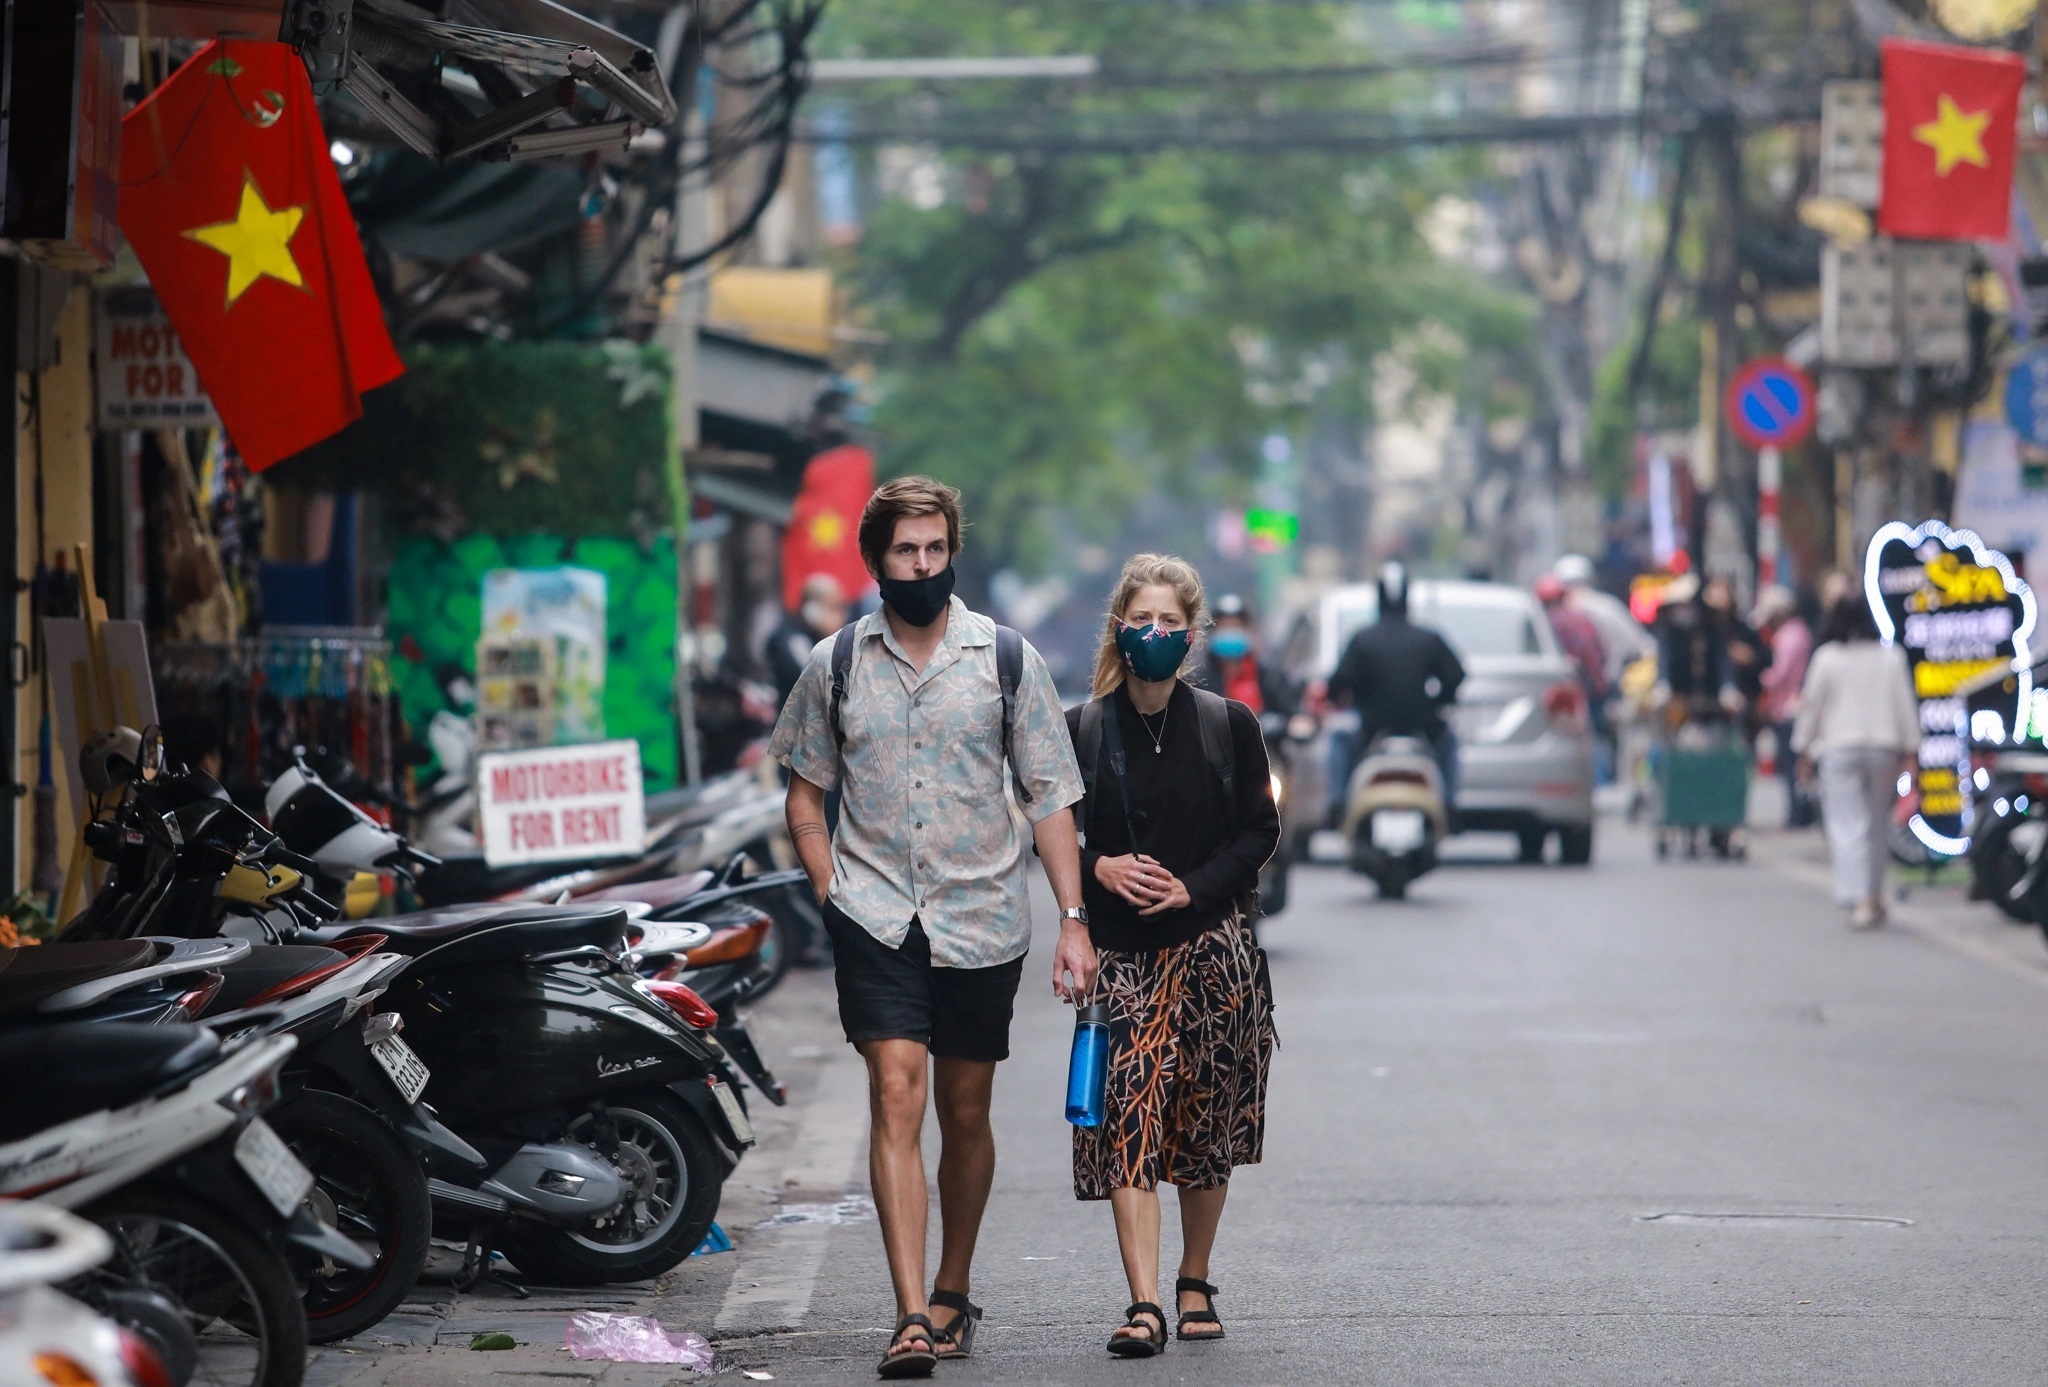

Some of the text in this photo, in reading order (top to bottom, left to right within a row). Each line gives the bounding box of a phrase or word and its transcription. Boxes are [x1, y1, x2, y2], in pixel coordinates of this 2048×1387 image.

[125, 363, 184, 397] FOR
[492, 755, 627, 804] MOTORBIKE
[510, 804, 621, 851] FOR RENT
